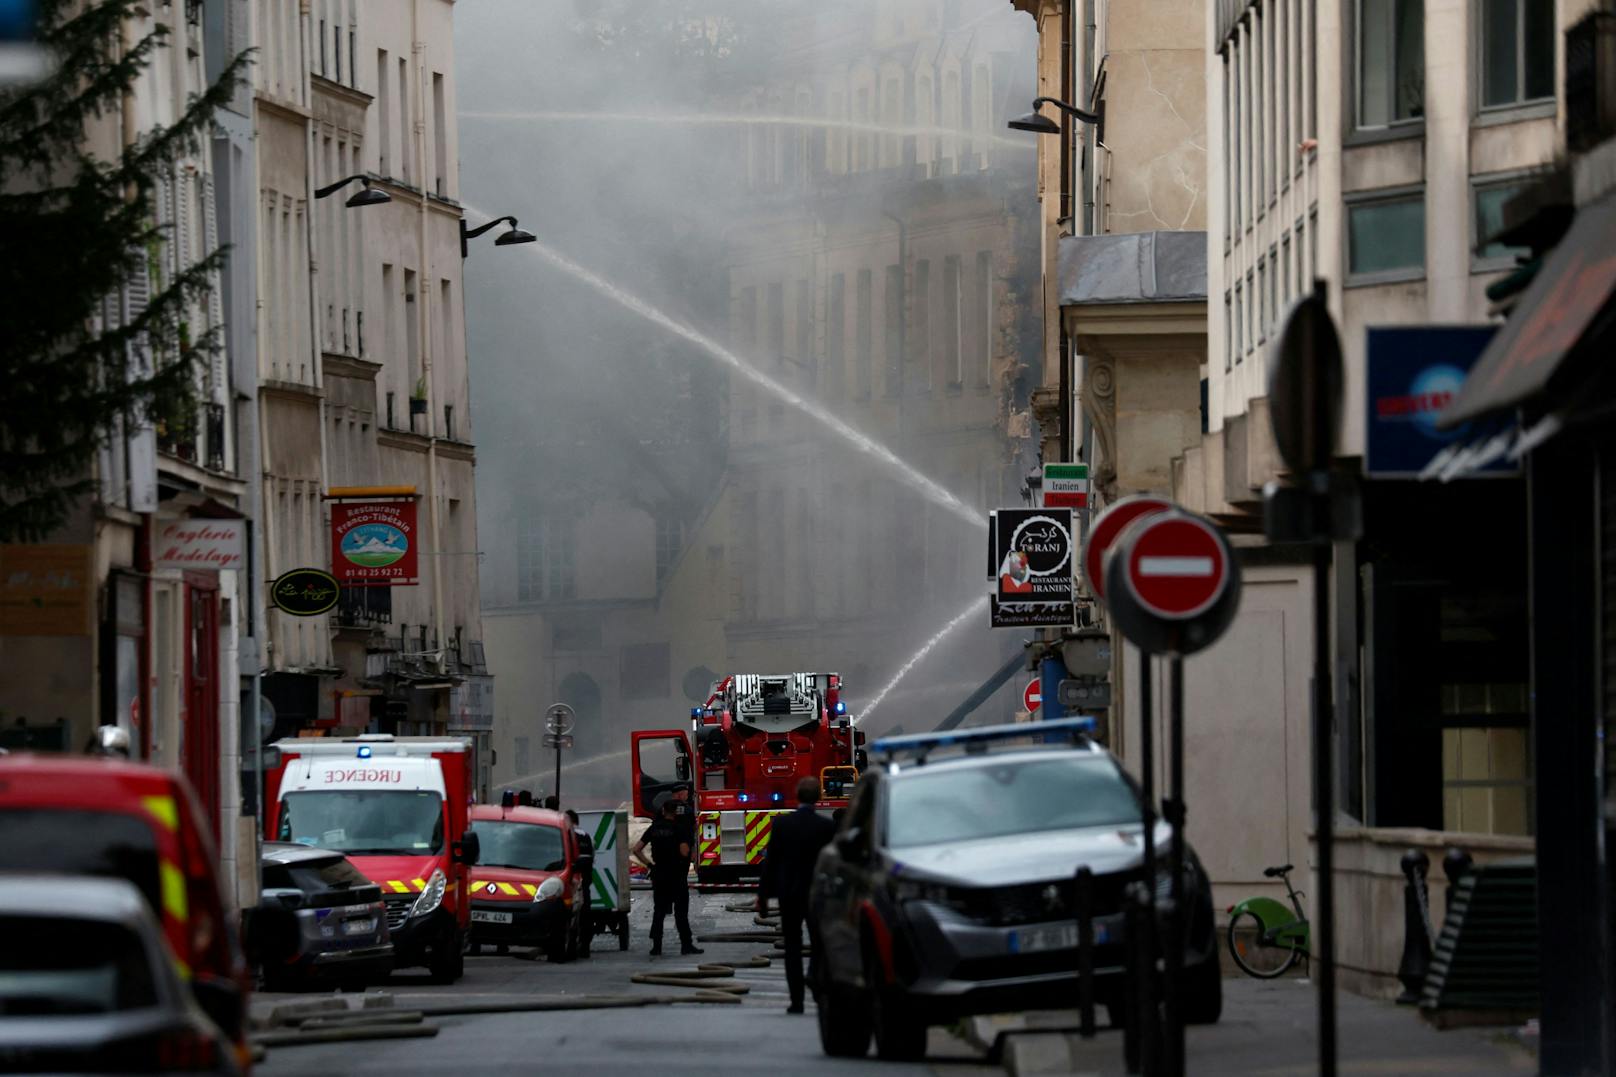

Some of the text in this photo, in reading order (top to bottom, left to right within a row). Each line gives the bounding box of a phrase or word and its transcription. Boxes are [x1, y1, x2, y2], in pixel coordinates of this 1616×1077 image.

[1052, 481, 1079, 491] Iranien
[347, 505, 401, 517] Restaurant
[336, 513, 411, 534] Franco-Tibétain
[1022, 543, 1060, 553] TORANJ
[345, 569, 355, 577] 01
[369, 568, 380, 577] 25
[381, 568, 391, 576] 92
[392, 567, 403, 576] 72
[1030, 576, 1071, 584] RESTAURANT
[1032, 584, 1071, 593] IRANIEN
